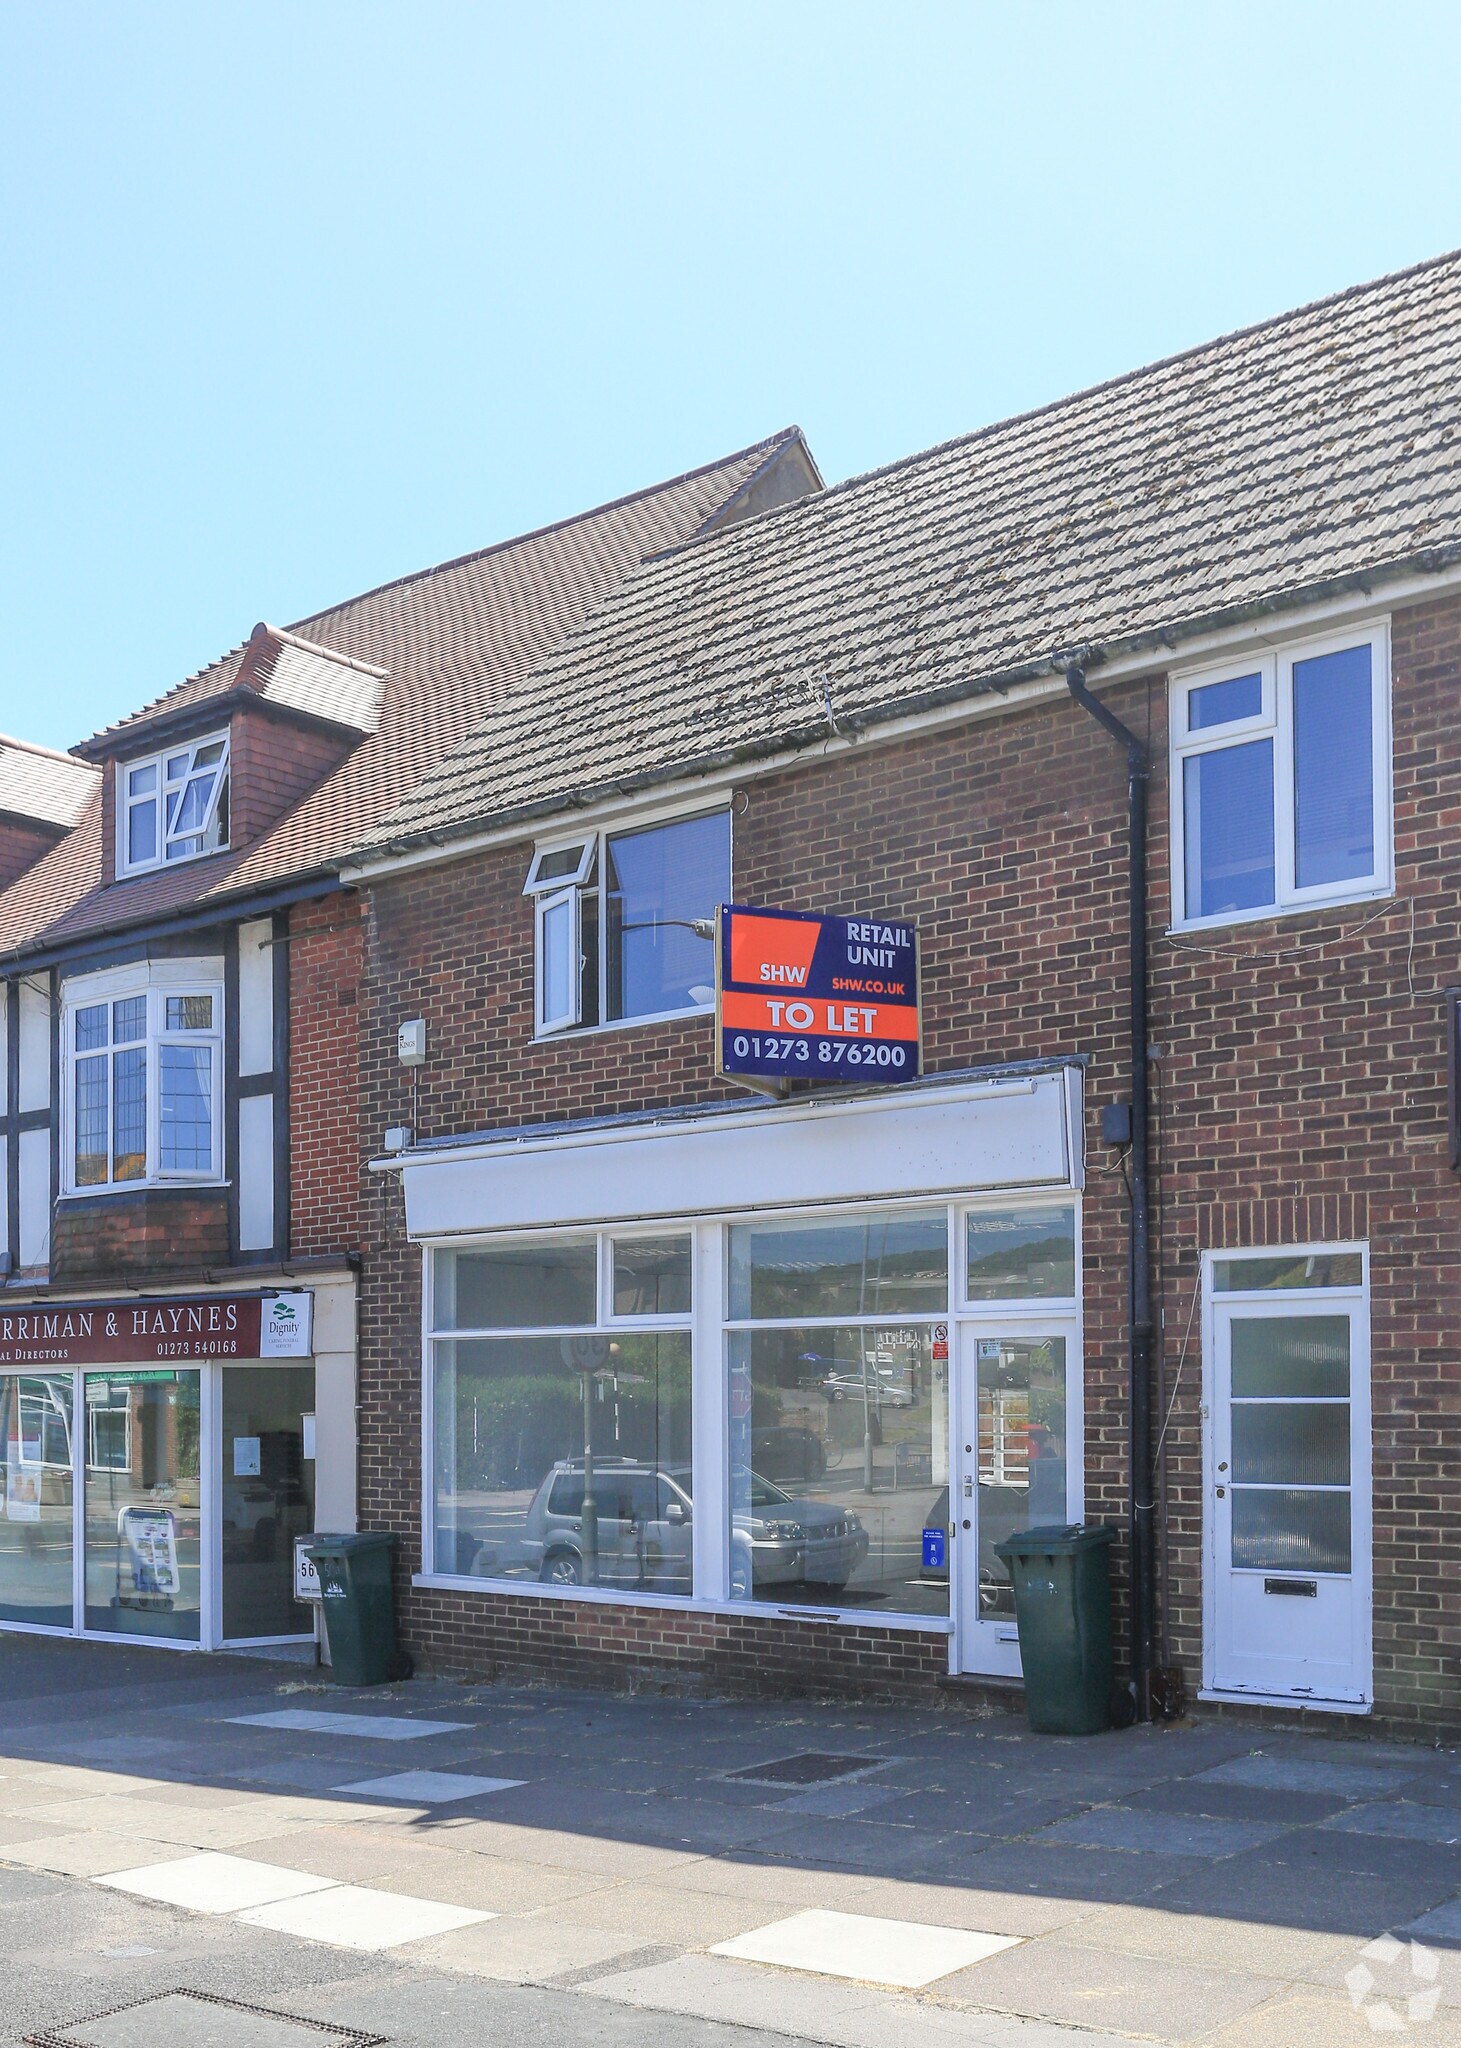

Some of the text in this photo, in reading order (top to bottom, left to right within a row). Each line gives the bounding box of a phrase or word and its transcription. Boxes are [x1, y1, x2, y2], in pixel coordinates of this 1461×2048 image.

[847, 922, 911, 948] RETAIL
[847, 946, 896, 969] UNIT
[759, 963, 806, 983] SHW
[832, 977, 905, 995] SHW.CO.UK
[766, 1001, 877, 1034] TO LET
[733, 1035, 906, 1067] 01273 876200
[105, 1312, 119, 1337] &
[131, 1303, 238, 1335] HAYNES
[269, 1321, 300, 1336] Dignity
[157, 1340, 237, 1356] 01273 540168
